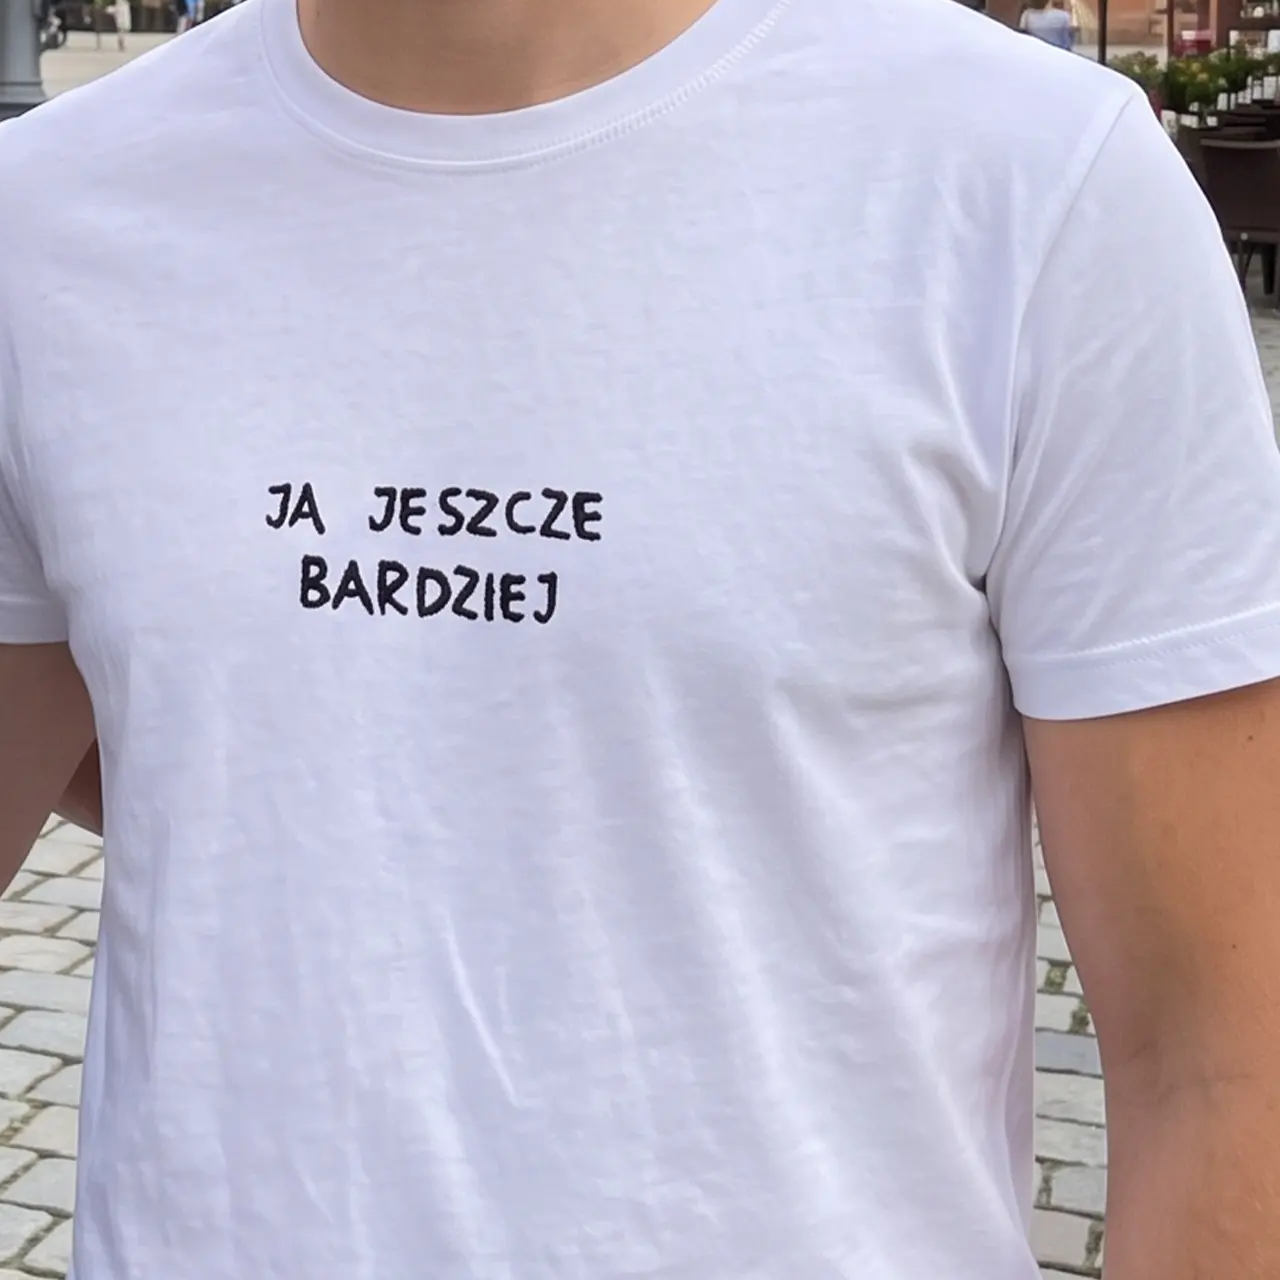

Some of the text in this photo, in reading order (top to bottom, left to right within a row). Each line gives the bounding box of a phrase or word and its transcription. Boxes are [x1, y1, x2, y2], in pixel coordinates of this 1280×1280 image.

[265, 482, 603, 542] JA JESZCZE
[299, 554, 558, 625] BARDZIEJ
